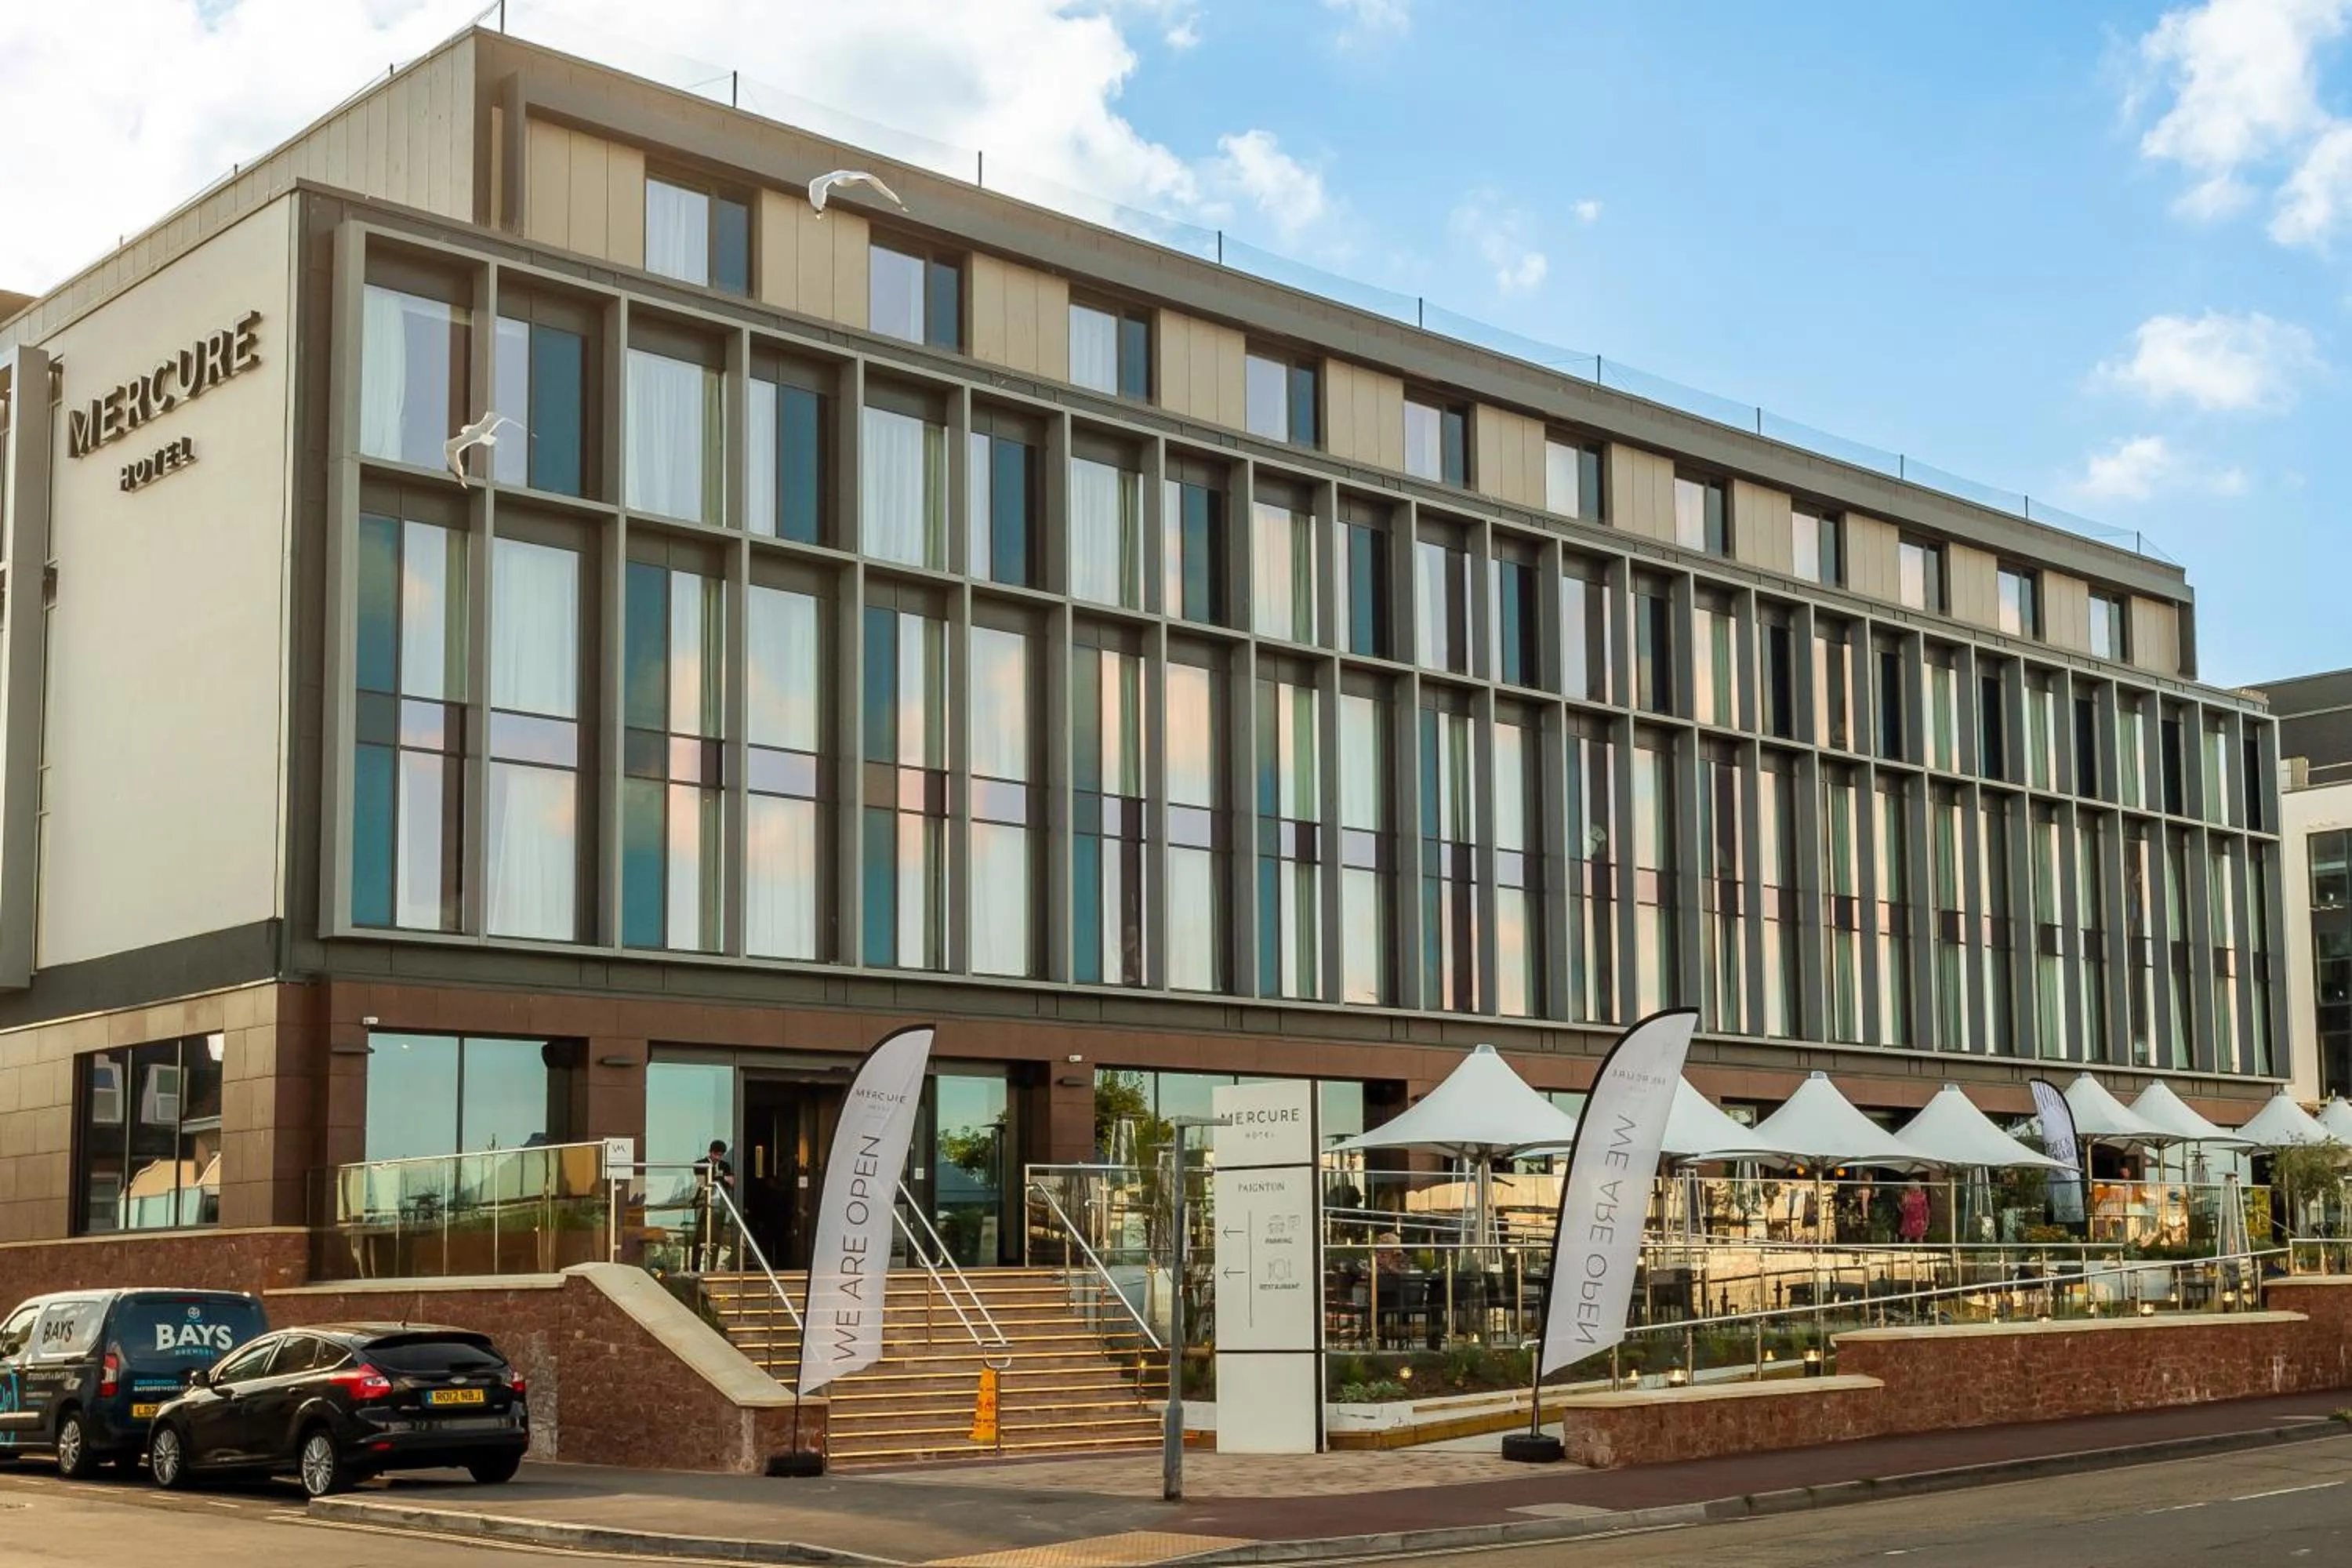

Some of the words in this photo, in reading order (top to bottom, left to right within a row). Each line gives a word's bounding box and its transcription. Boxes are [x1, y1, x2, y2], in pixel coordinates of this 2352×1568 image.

[67, 310, 261, 458] MERCURE
[120, 437, 198, 492] HOTEL
[846, 1135, 880, 1225] OPEN
[1238, 1181, 1285, 1192] PAIGNTON
[840, 1234, 867, 1301] ARE
[42, 1319, 74, 1344] BAYS
[155, 1324, 233, 1351] BAYS
[833, 1310, 861, 1361] WE
